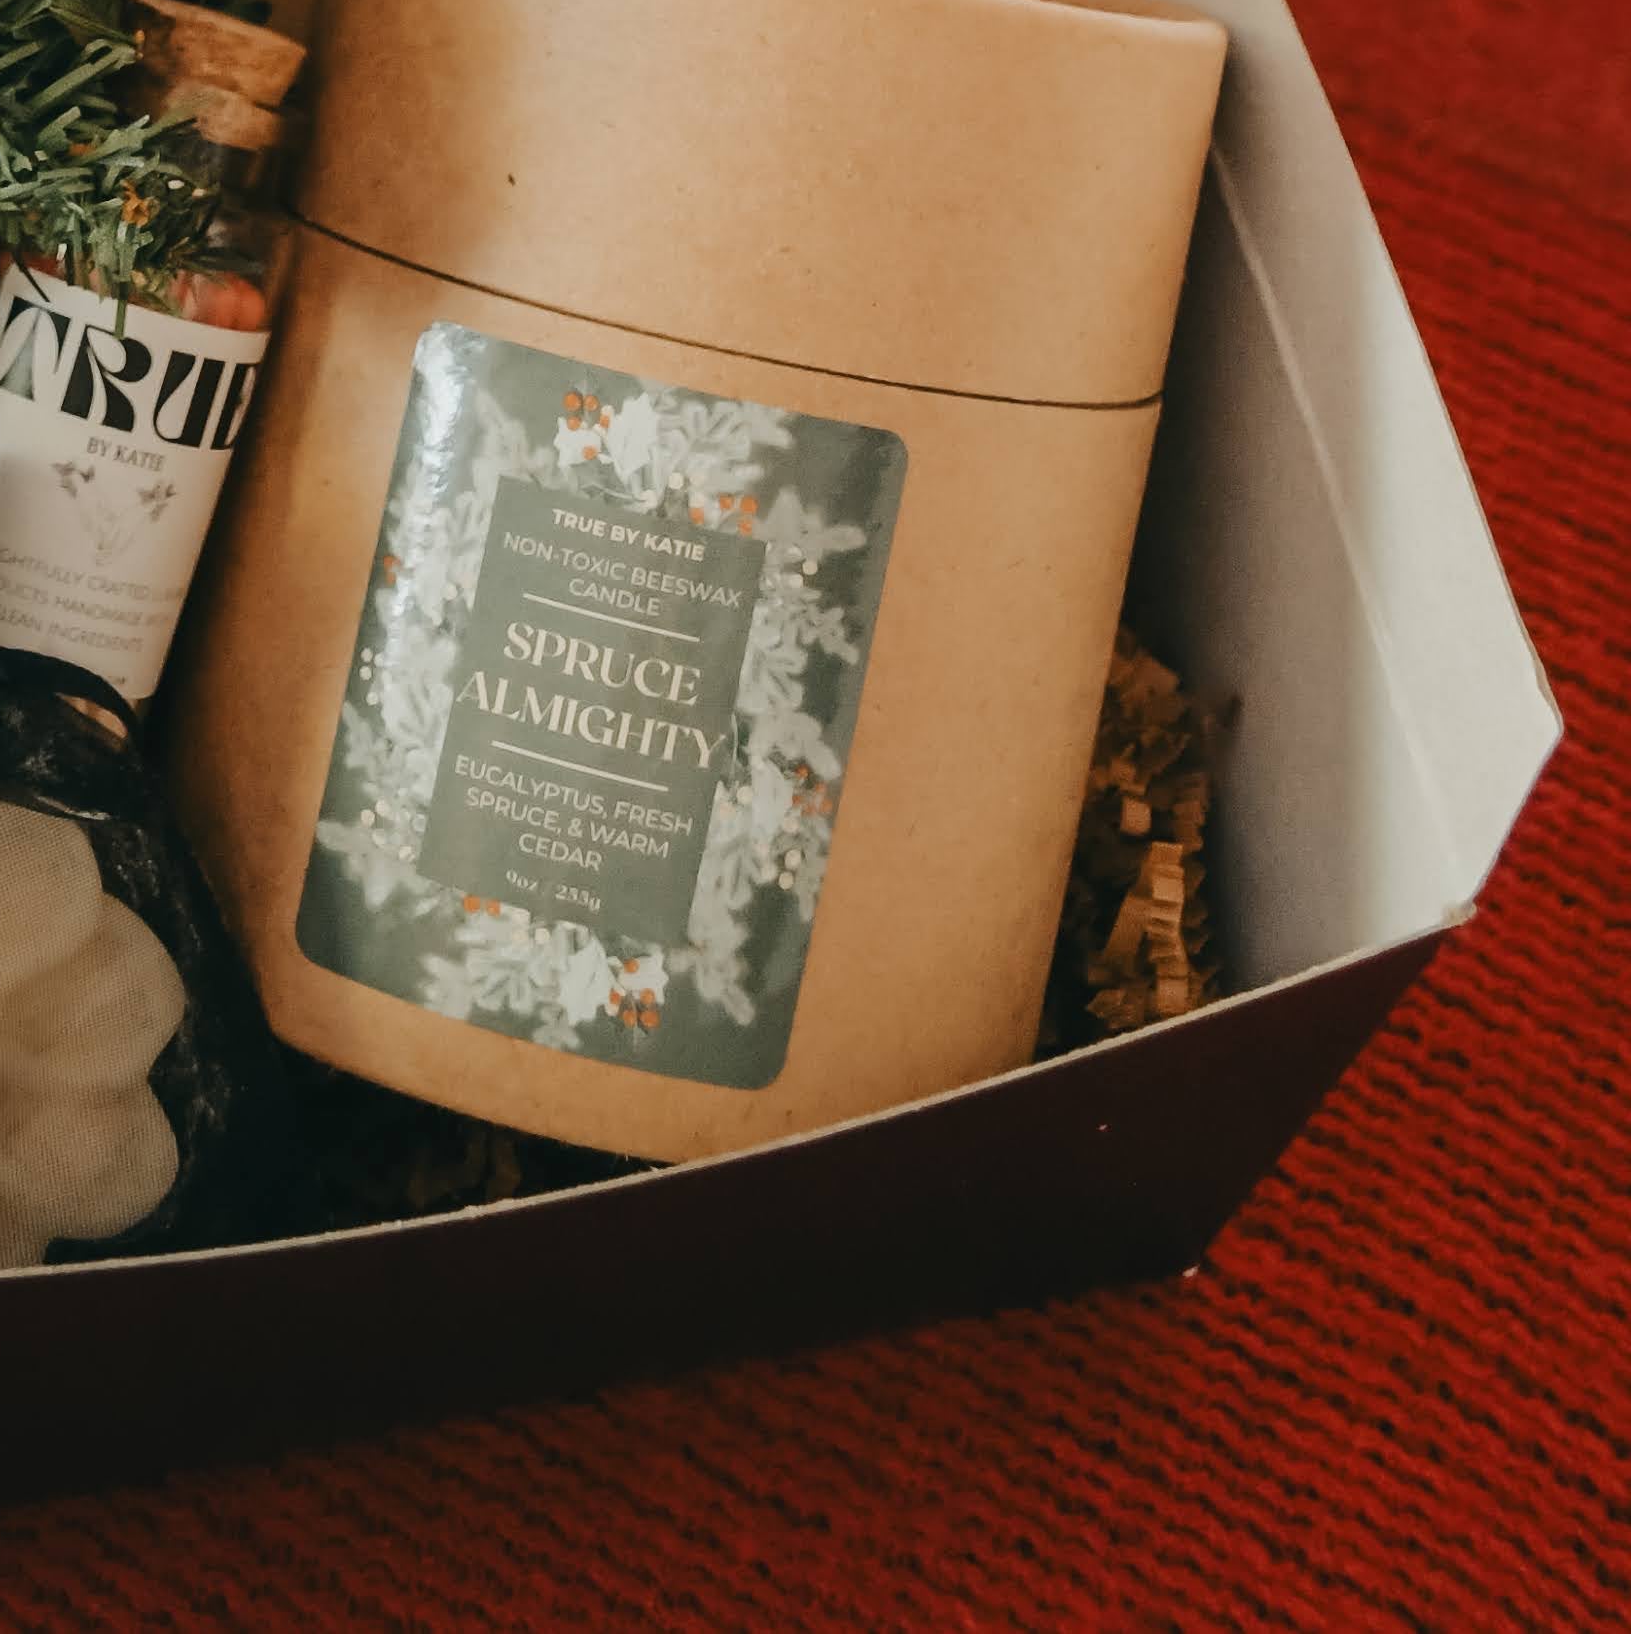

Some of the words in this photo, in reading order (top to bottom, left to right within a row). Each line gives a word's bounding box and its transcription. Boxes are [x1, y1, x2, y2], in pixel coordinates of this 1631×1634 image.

[87, 436, 111, 457] BY
[503, 531, 628, 581] NON-TOXIC
[630, 566, 744, 608] BEESWAX
[552, 508, 606, 537] TRUE
[610, 524, 641, 545] BY
[643, 533, 706, 562] KATIE
[568, 577, 662, 617] CANDLE
[503, 620, 701, 707] SPRUCE
[456, 670, 727, 769] ALMIGHTY
[454, 754, 608, 820] EUCALYPTUS,
[613, 800, 694, 836] FRESH
[466, 786, 562, 835] SPRUCE,
[567, 816, 584, 839] &
[589, 820, 670, 859] WARM
[518, 832, 603, 872] CEDAR
